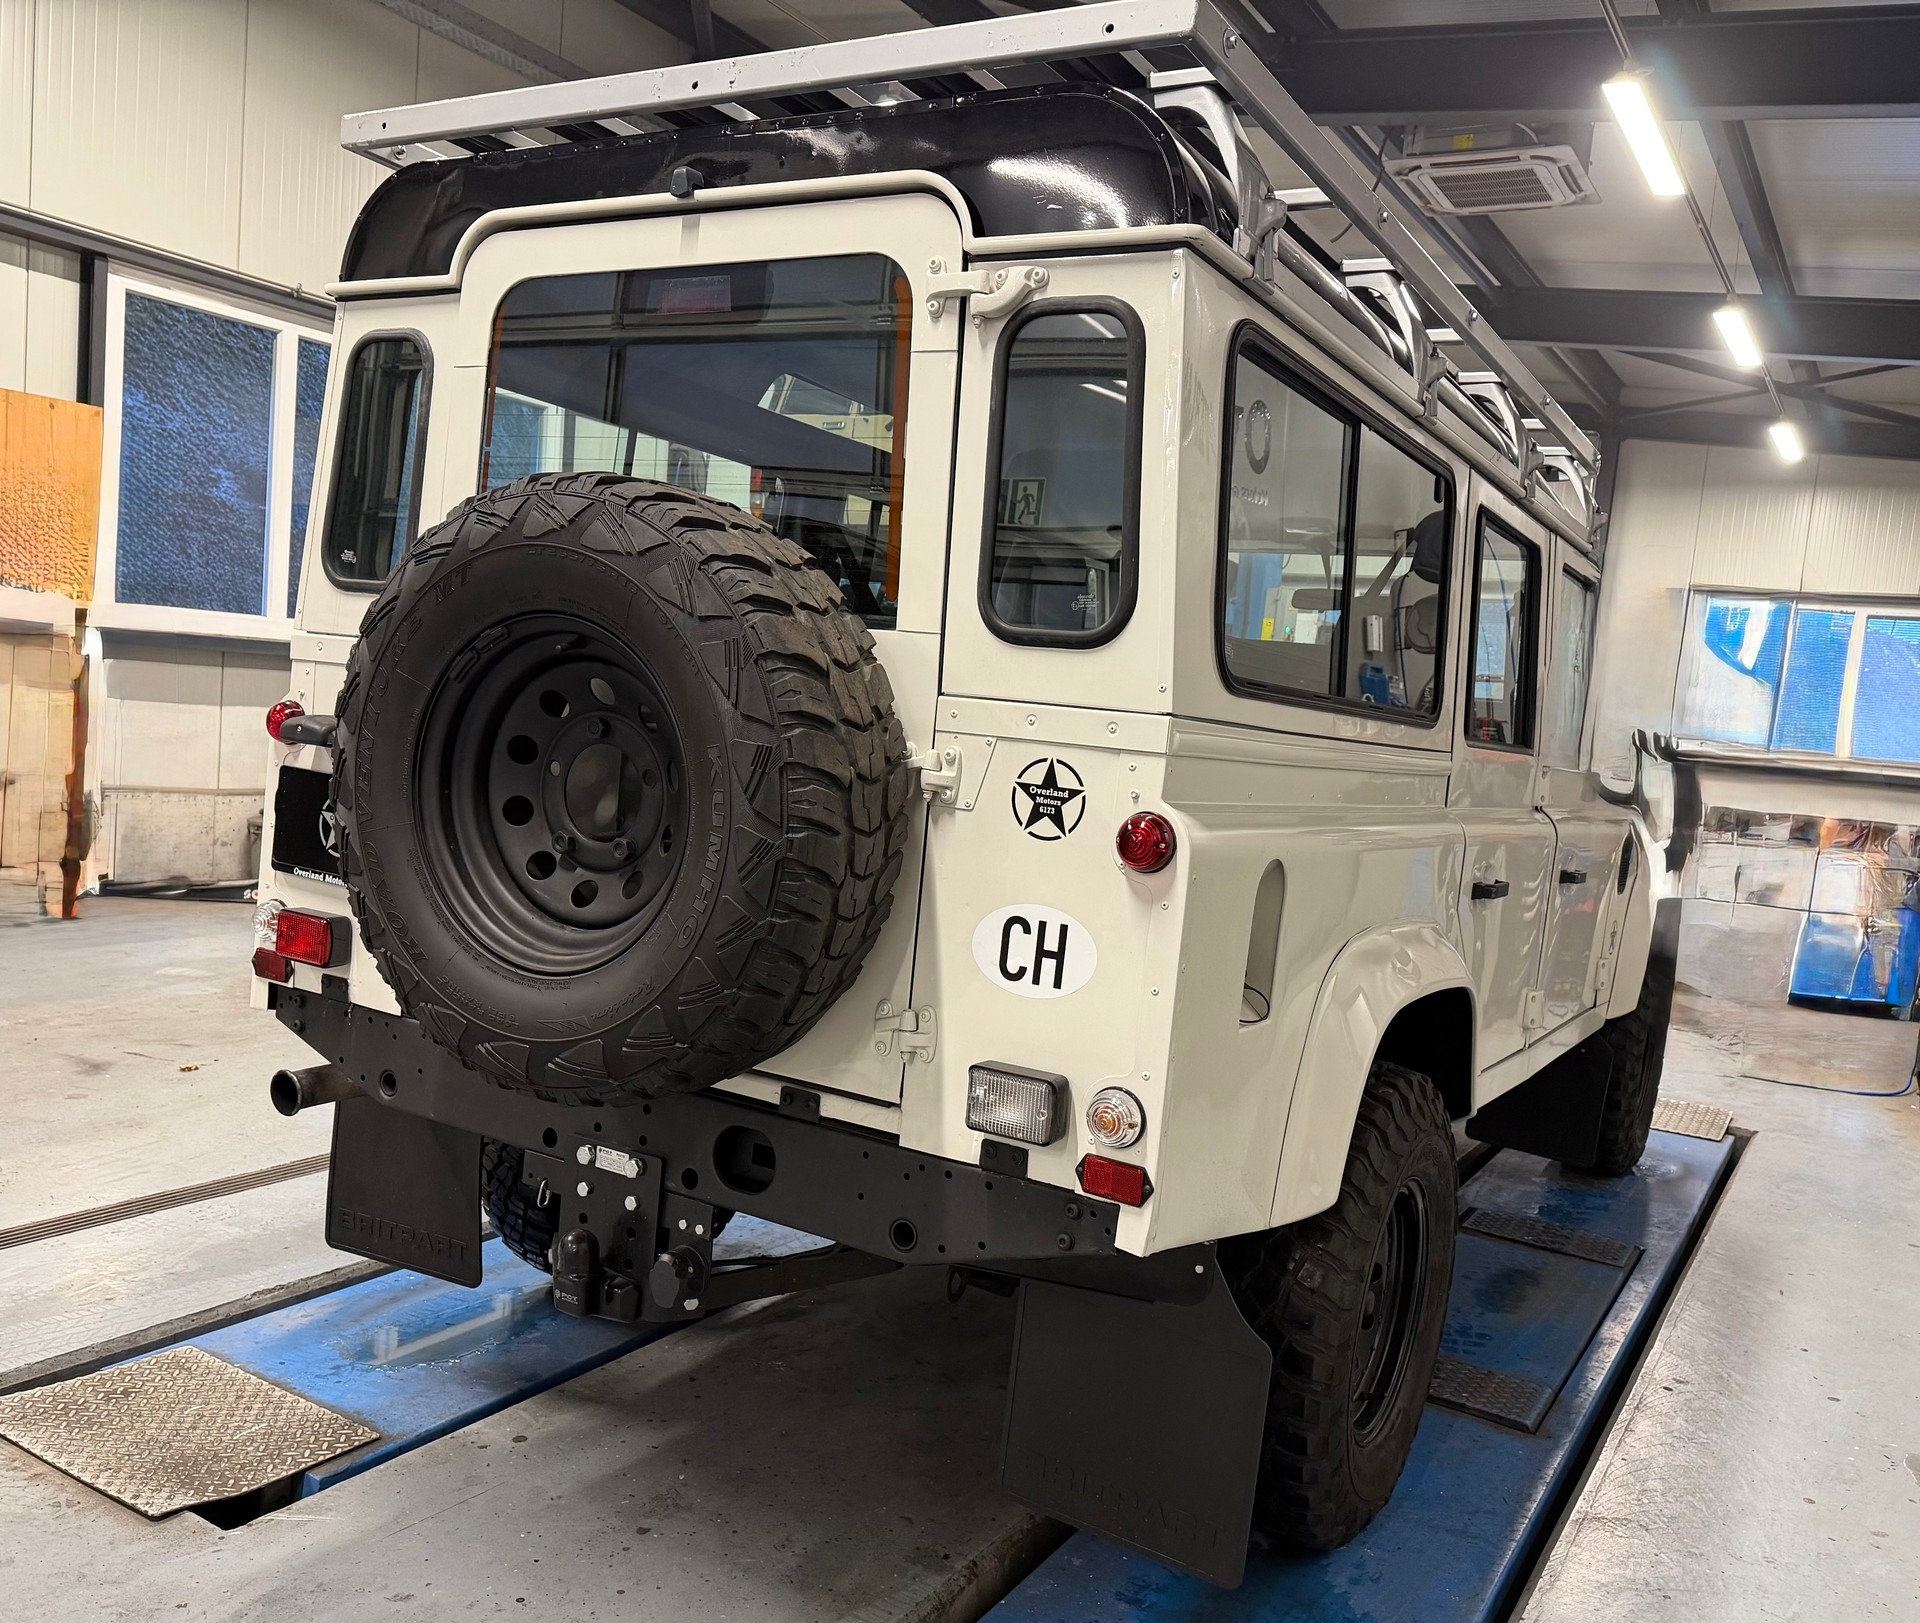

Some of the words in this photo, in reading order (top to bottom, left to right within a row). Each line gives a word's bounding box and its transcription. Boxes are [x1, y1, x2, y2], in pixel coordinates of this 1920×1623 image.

[433, 564, 472, 606] MT
[356, 606, 424, 825] VENTURE
[1029, 786, 1069, 798] Overland
[1035, 796, 1062, 806] Motors
[677, 743, 725, 949] KUMHO
[293, 867, 324, 881] Overland
[363, 841, 429, 962] ROAD
[999, 915, 1068, 989] CH
[337, 1207, 468, 1261] BRITPART
[561, 1292, 578, 1301] PCT
